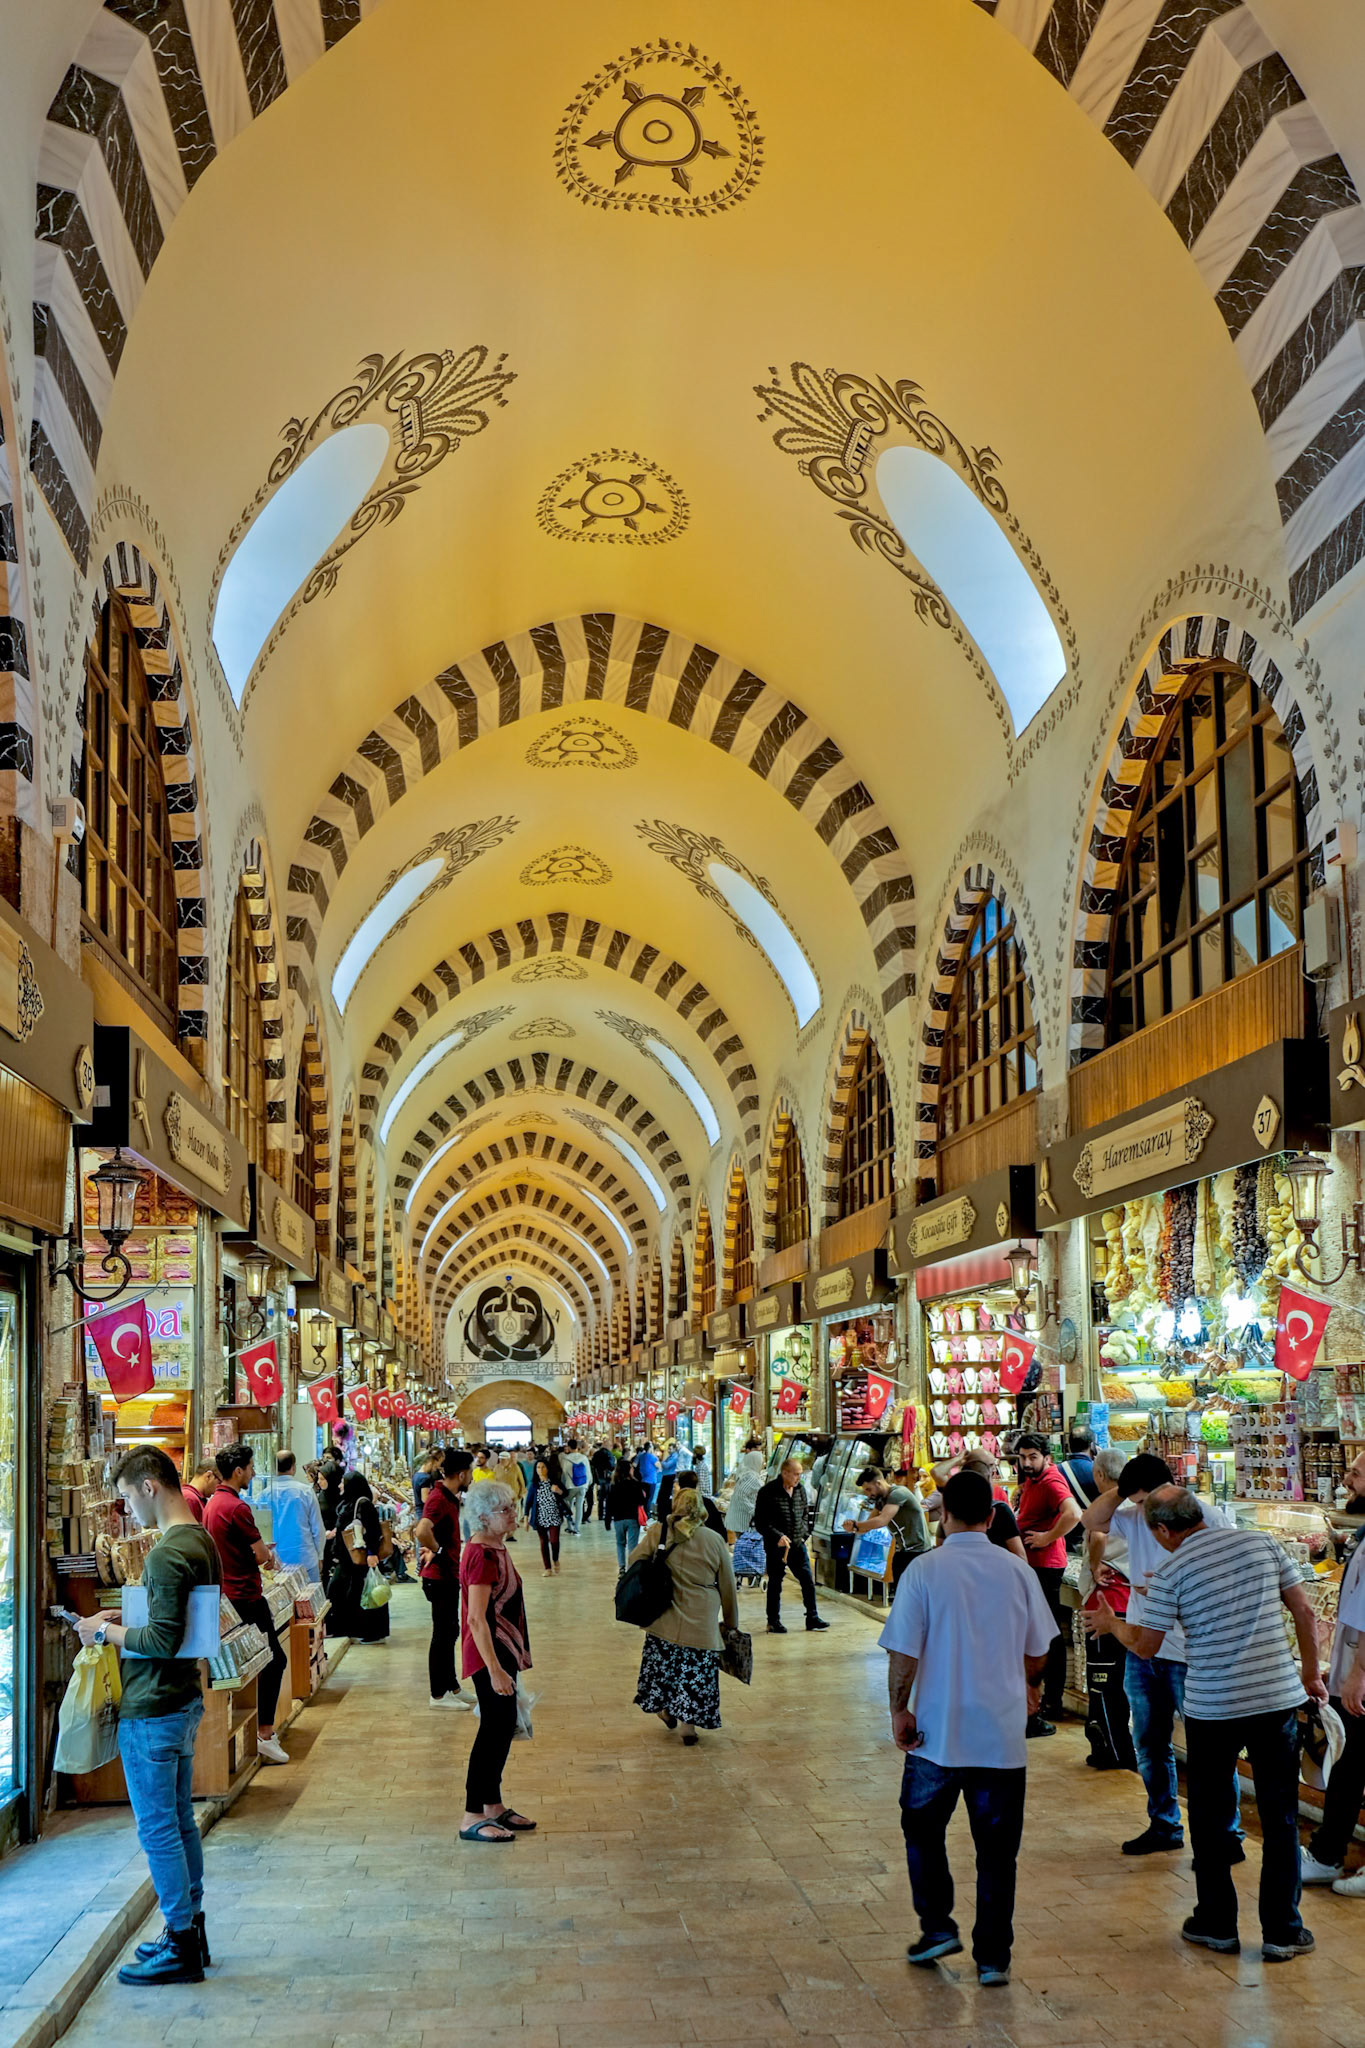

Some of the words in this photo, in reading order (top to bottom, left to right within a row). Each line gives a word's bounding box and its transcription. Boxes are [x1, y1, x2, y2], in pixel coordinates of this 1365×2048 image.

[82, 1061, 93, 1092] 38
[1257, 1108, 1272, 1135] 37
[1101, 1128, 1173, 1171] Haremsaray
[947, 1210, 958, 1236] Gift
[998, 1211, 1005, 1228] 35
[773, 1361, 788, 1373] 31
